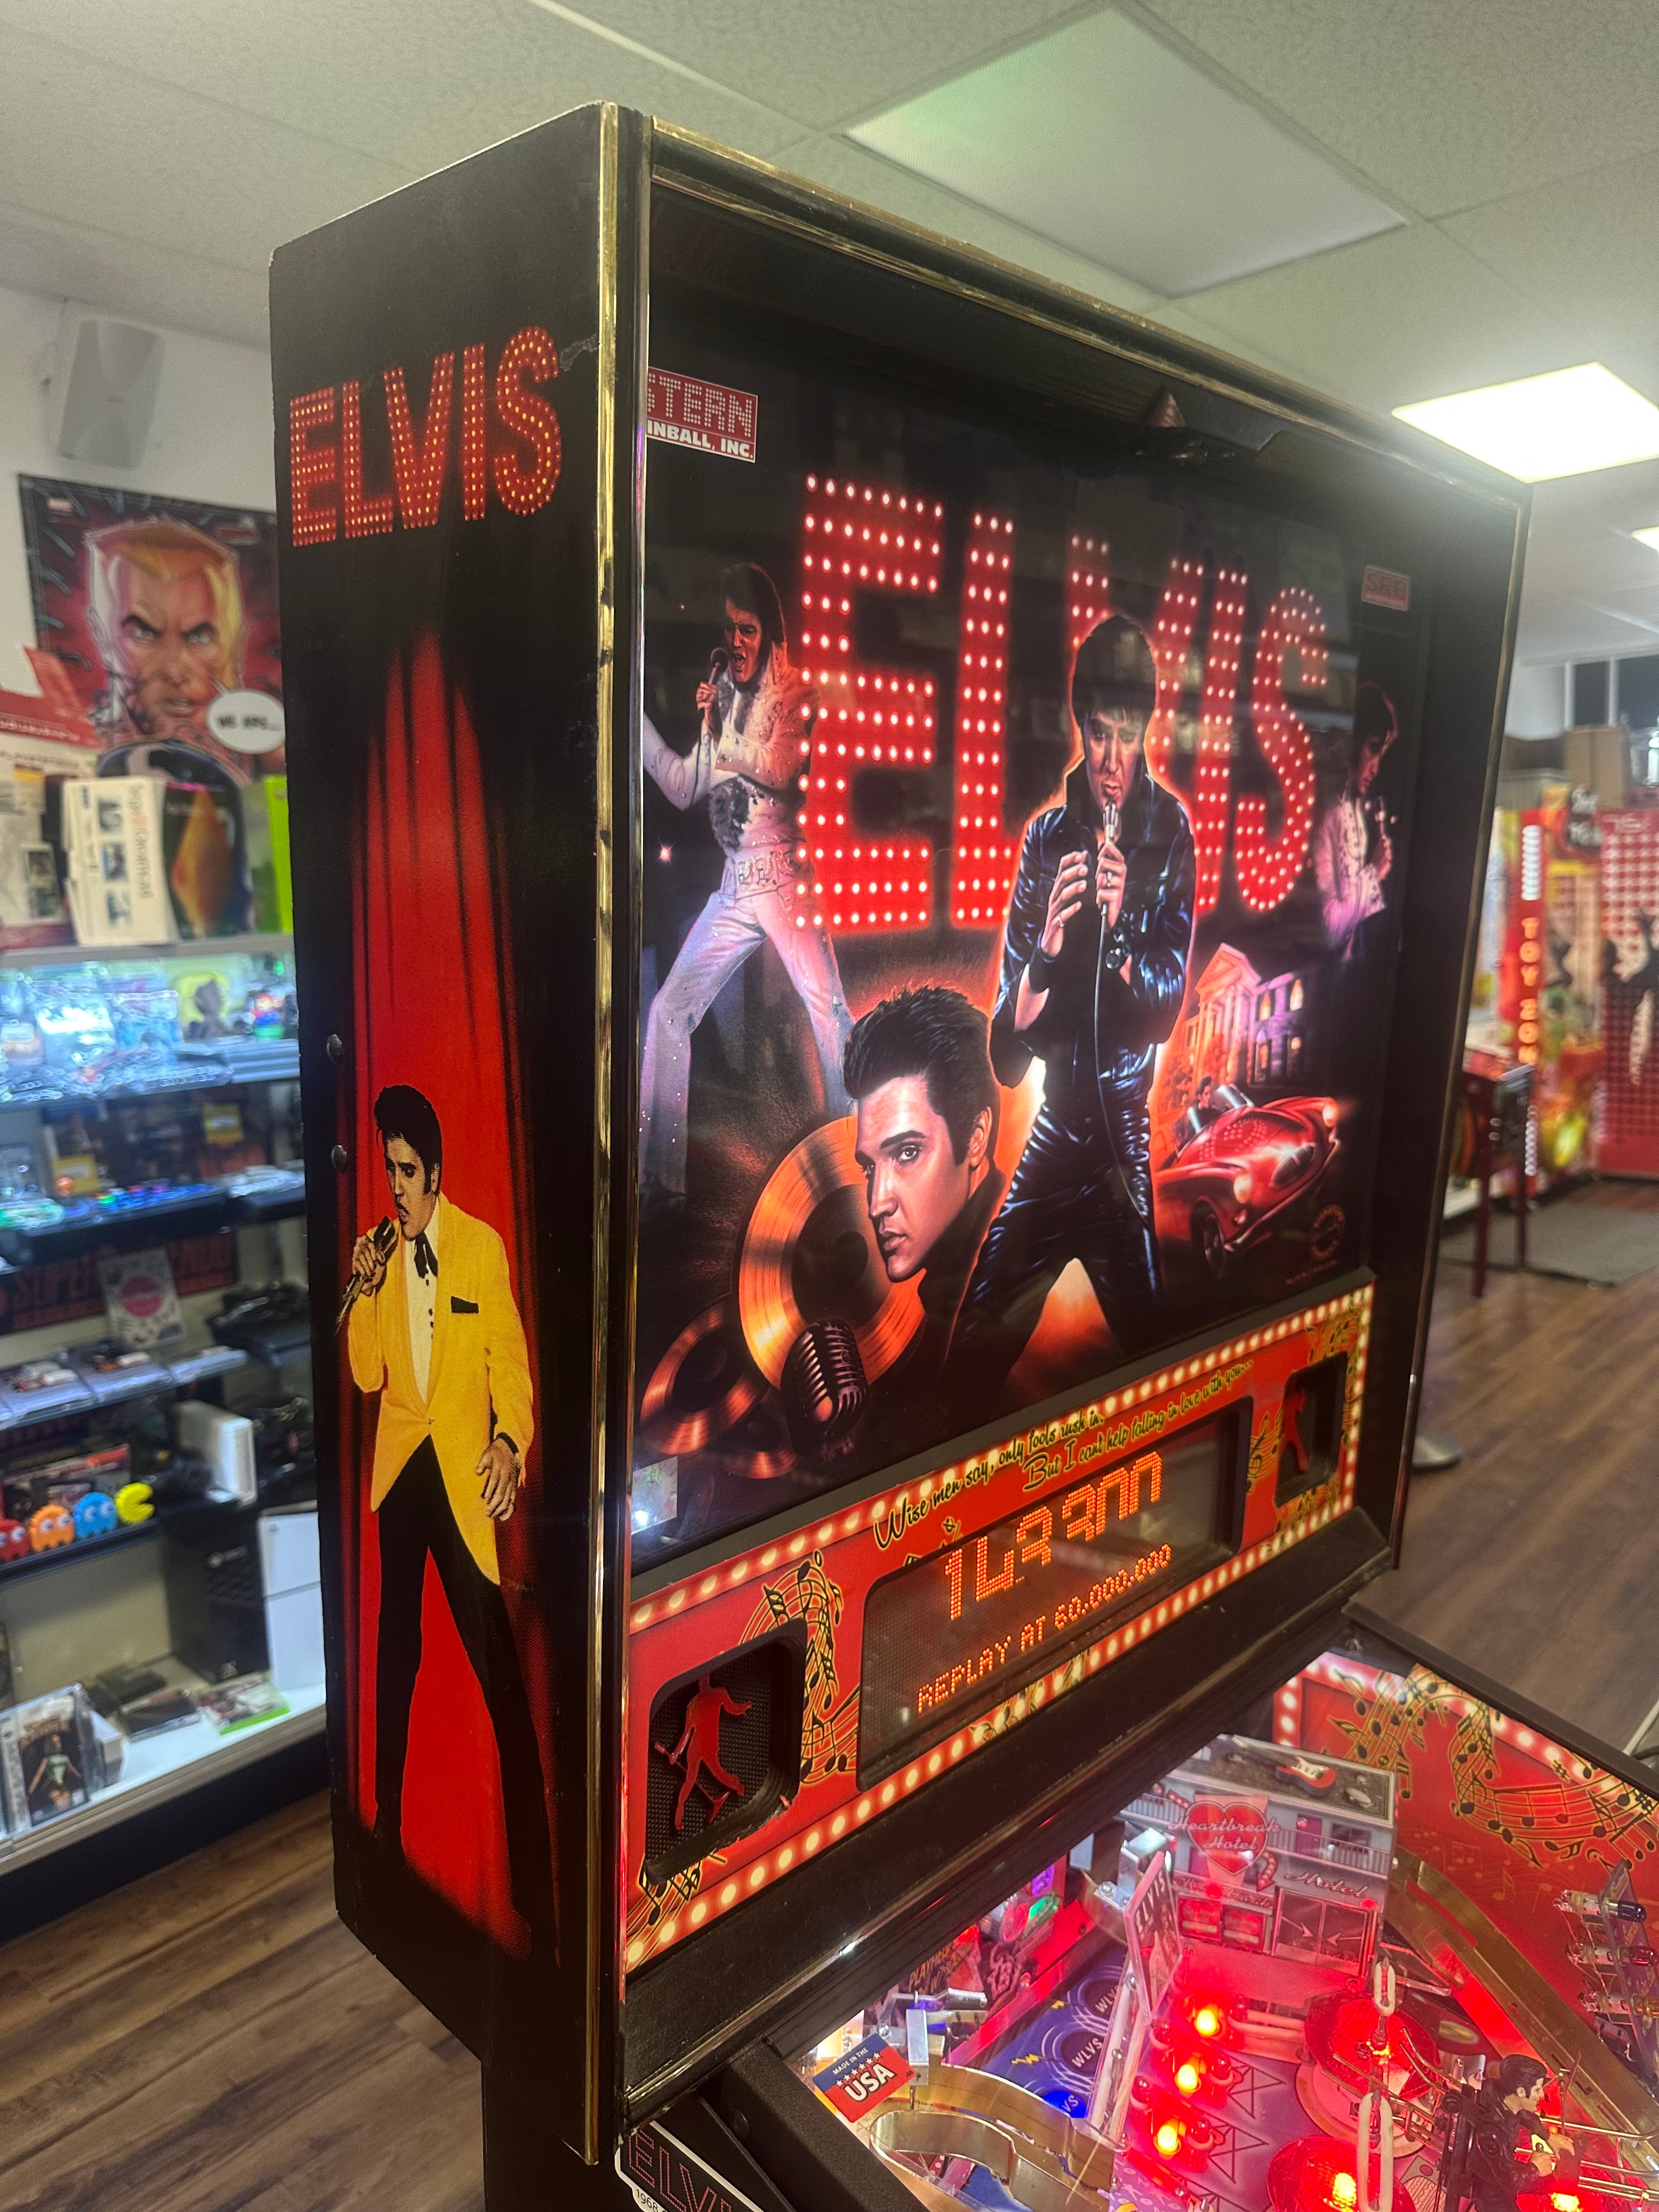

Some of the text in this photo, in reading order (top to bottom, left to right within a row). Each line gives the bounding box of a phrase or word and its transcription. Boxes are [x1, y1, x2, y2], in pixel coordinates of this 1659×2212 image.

[290, 325, 562, 548] ELVIS
[720, 437, 754, 459] INC.
[1022, 1453, 1062, 1490] But
[1064, 1438, 1076, 1471] I
[1106, 1423, 1129, 1451] help
[1131, 1411, 1167, 1440] falling
[1168, 1403, 1179, 1419] in
[1181, 1390, 1201, 1413] love
[1203, 1370, 1224, 1398] with
[873, 1497, 929, 1549] Wise
[933, 1480, 961, 1508] men
[964, 1460, 994, 1487] say,
[998, 1436, 1024, 1464] only
[1028, 1421, 1057, 1454] fools
[1060, 1408, 1086, 1437] rush
[917, 1634, 1012, 1714] REPLAY
[1020, 1615, 1047, 1652] AT
[1167, 1816, 1281, 1833] Heartbreak
[1202, 1833, 1258, 1850] Hotel
[1284, 1871, 1369, 1898] Hotel
[832, 2046, 869, 2075] MADE IN THE
[1071, 2036, 1103, 2069] WLVS
[843, 2062, 897, 2102] USA
